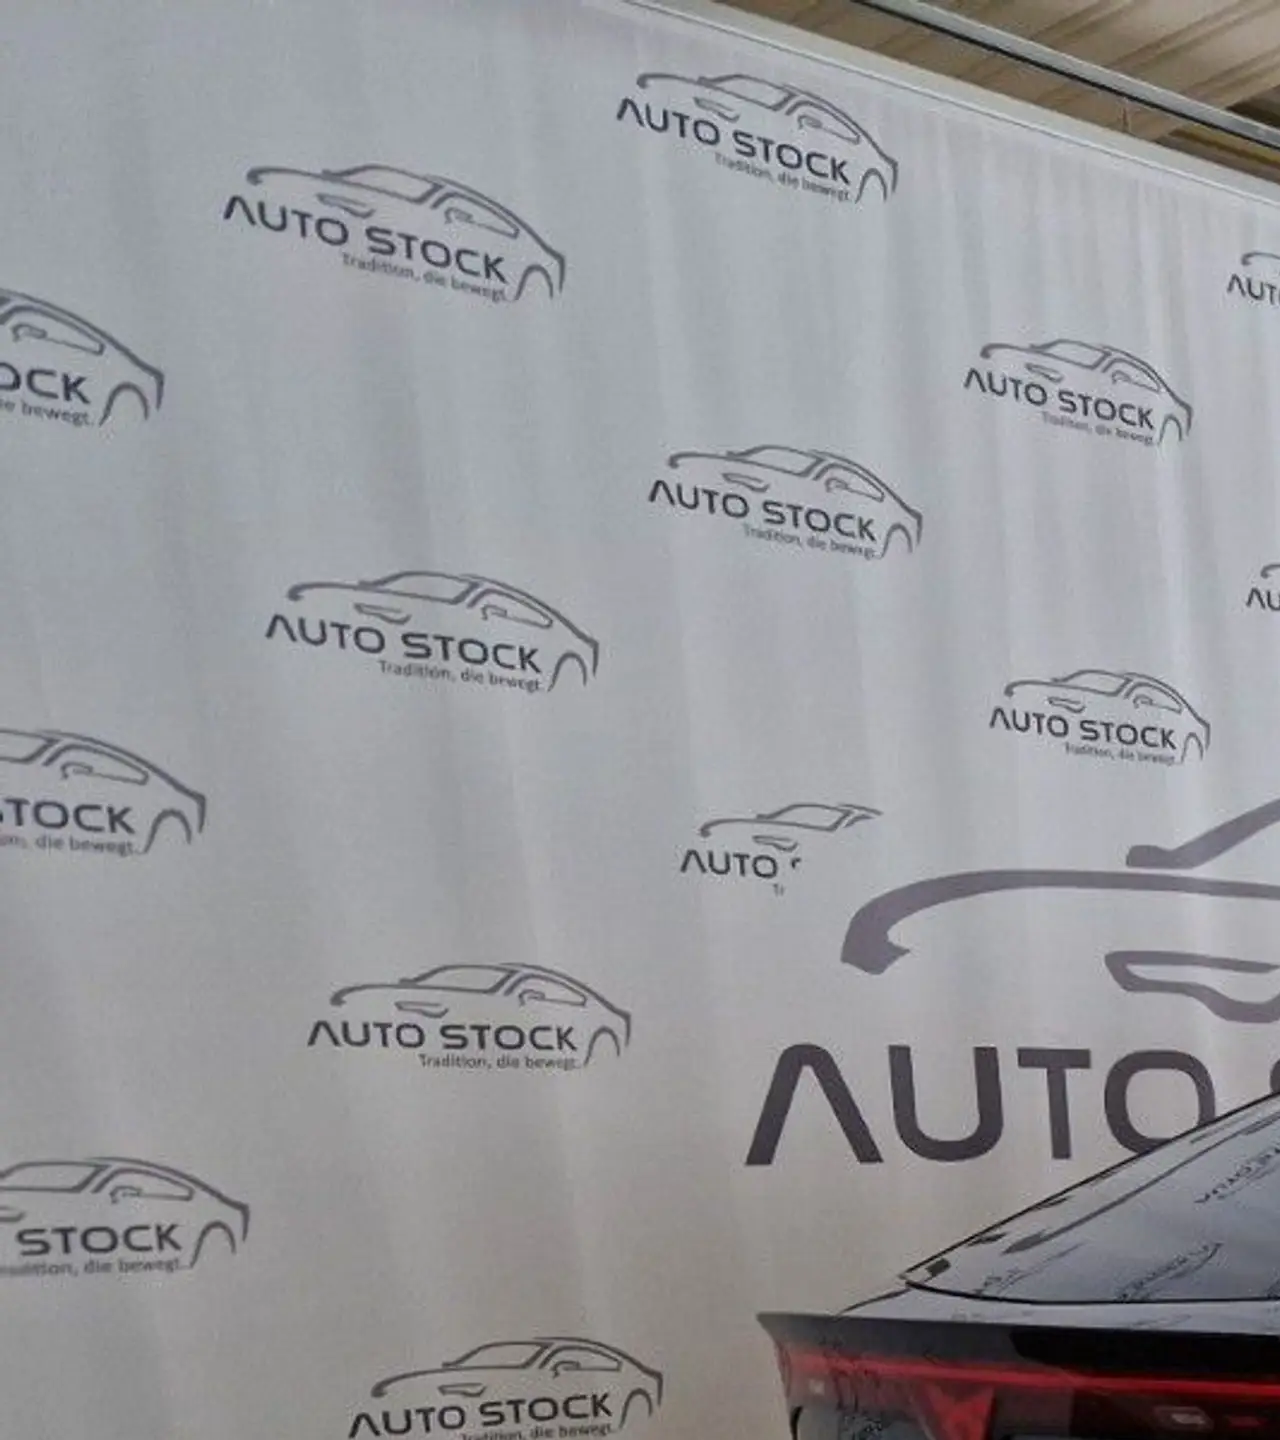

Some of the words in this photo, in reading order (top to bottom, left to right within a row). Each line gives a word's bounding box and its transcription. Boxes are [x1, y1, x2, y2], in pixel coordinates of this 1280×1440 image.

[617, 98, 719, 146] AUTO
[732, 133, 850, 183] STOCK
[223, 195, 348, 245] AUTO
[366, 227, 506, 282] STOCK
[964, 368, 1048, 405] AUTO
[1058, 390, 1155, 430] STOCK
[649, 480, 750, 518] AUTO
[763, 501, 878, 541] STOCK
[266, 614, 385, 654] AUTO
[403, 633, 542, 673] STOCK
[380, 657, 456, 683] Tradition,
[461, 668, 484, 684] die
[989, 707, 1069, 738] AUTO
[1080, 720, 1177, 750] STOCK
[0, 798, 135, 834] TOCK
[681, 849, 778, 878] AUTO
[308, 1019, 423, 1049] AUTO
[440, 1023, 578, 1050] STOCK
[420, 1054, 495, 1070] Tradition,
[498, 1054, 519, 1068] die
[744, 1042, 1216, 1167] AUTO
[18, 1224, 182, 1255] STOCK
[84, 1259, 110, 1274] die
[348, 1406, 465, 1440] AUTO
[479, 1393, 613, 1426] STOCK
[530, 1426, 553, 1440] die
